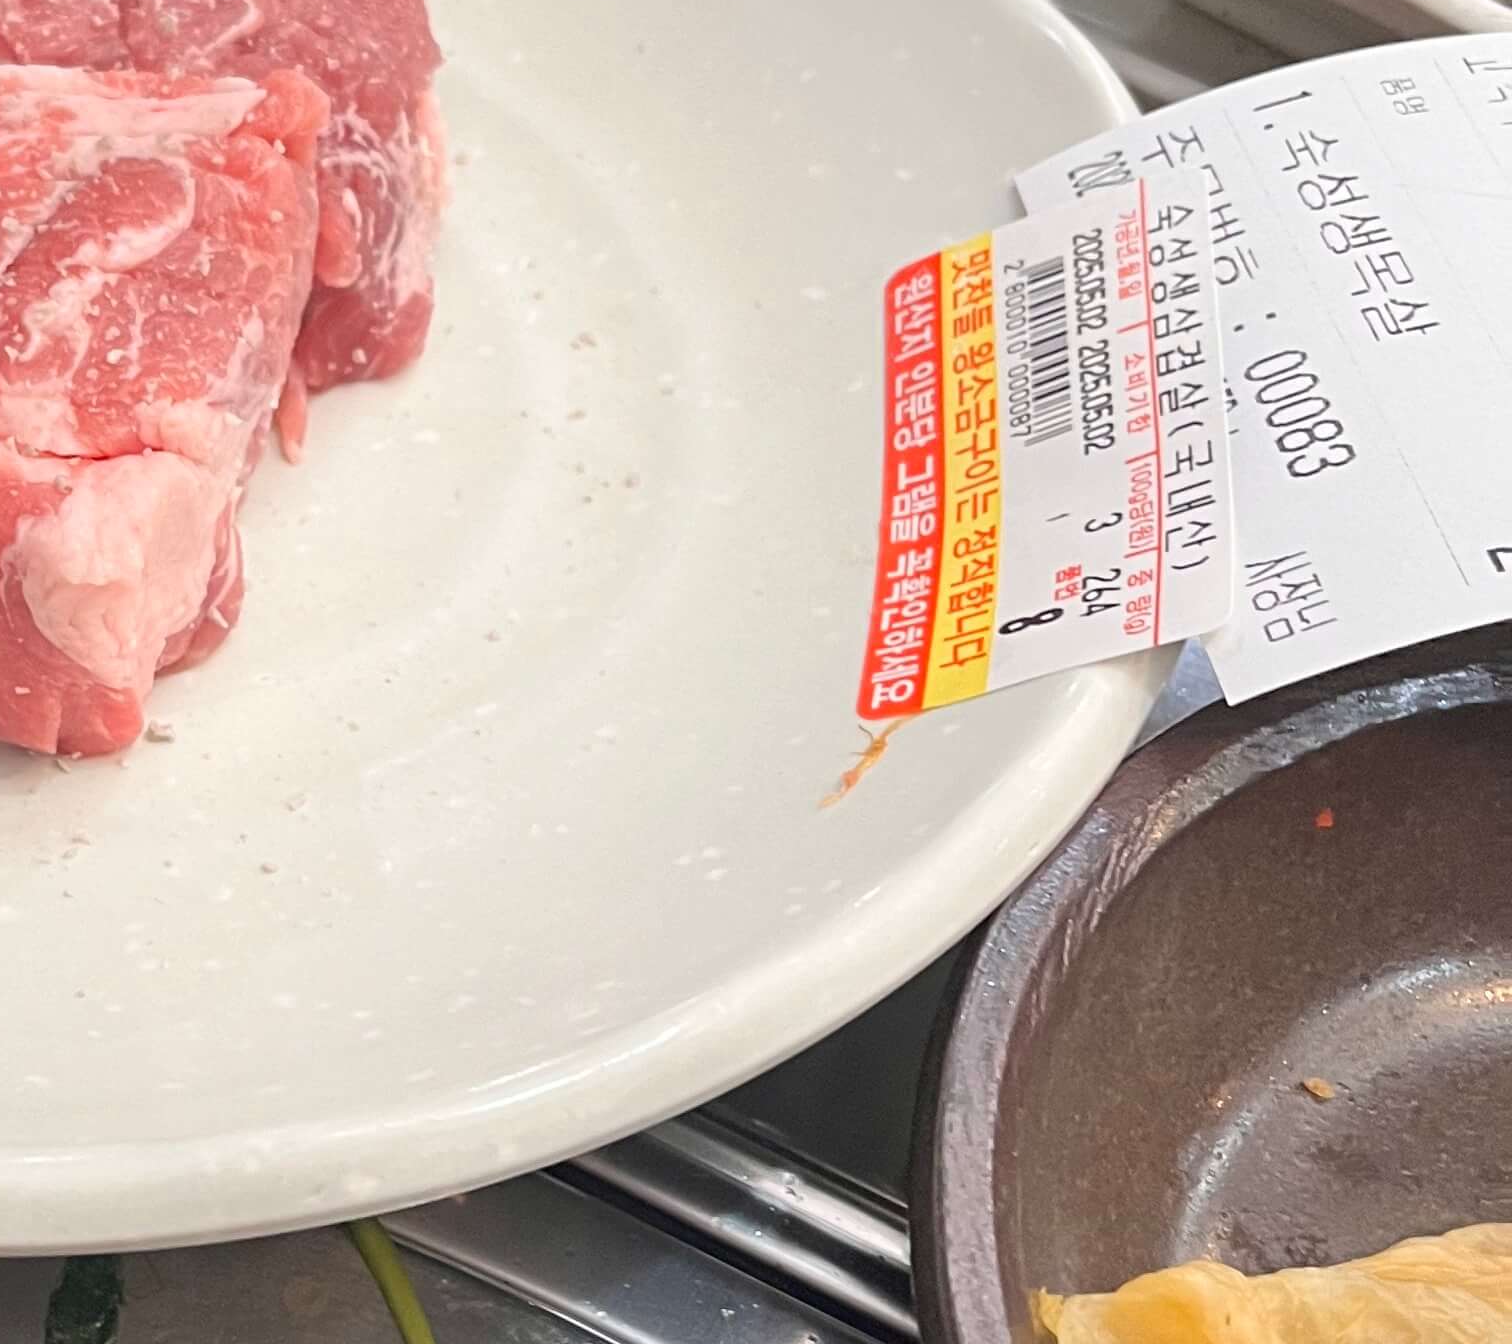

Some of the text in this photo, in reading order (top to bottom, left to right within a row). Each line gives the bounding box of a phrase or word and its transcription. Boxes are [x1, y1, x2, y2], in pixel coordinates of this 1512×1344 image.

[1073, 228, 1108, 334] 2025.05.02
[1008, 364, 1032, 438] 000087
[1078, 339, 1115, 456] 2025.05.02
[1148, 206, 1216, 570] 숙성생삼겹살(국내산)
[1245, 350, 1356, 477] 00083
[871, 273, 938, 709] 원산지 인분당 그램을 꼭확인하세요
[939, 249, 999, 669] 맛찬들 왕소금구이는 정직합니다
[999, 608, 1064, 635] 8
[1080, 568, 1121, 617] 264
[1244, 551, 1338, 642] 사장님
